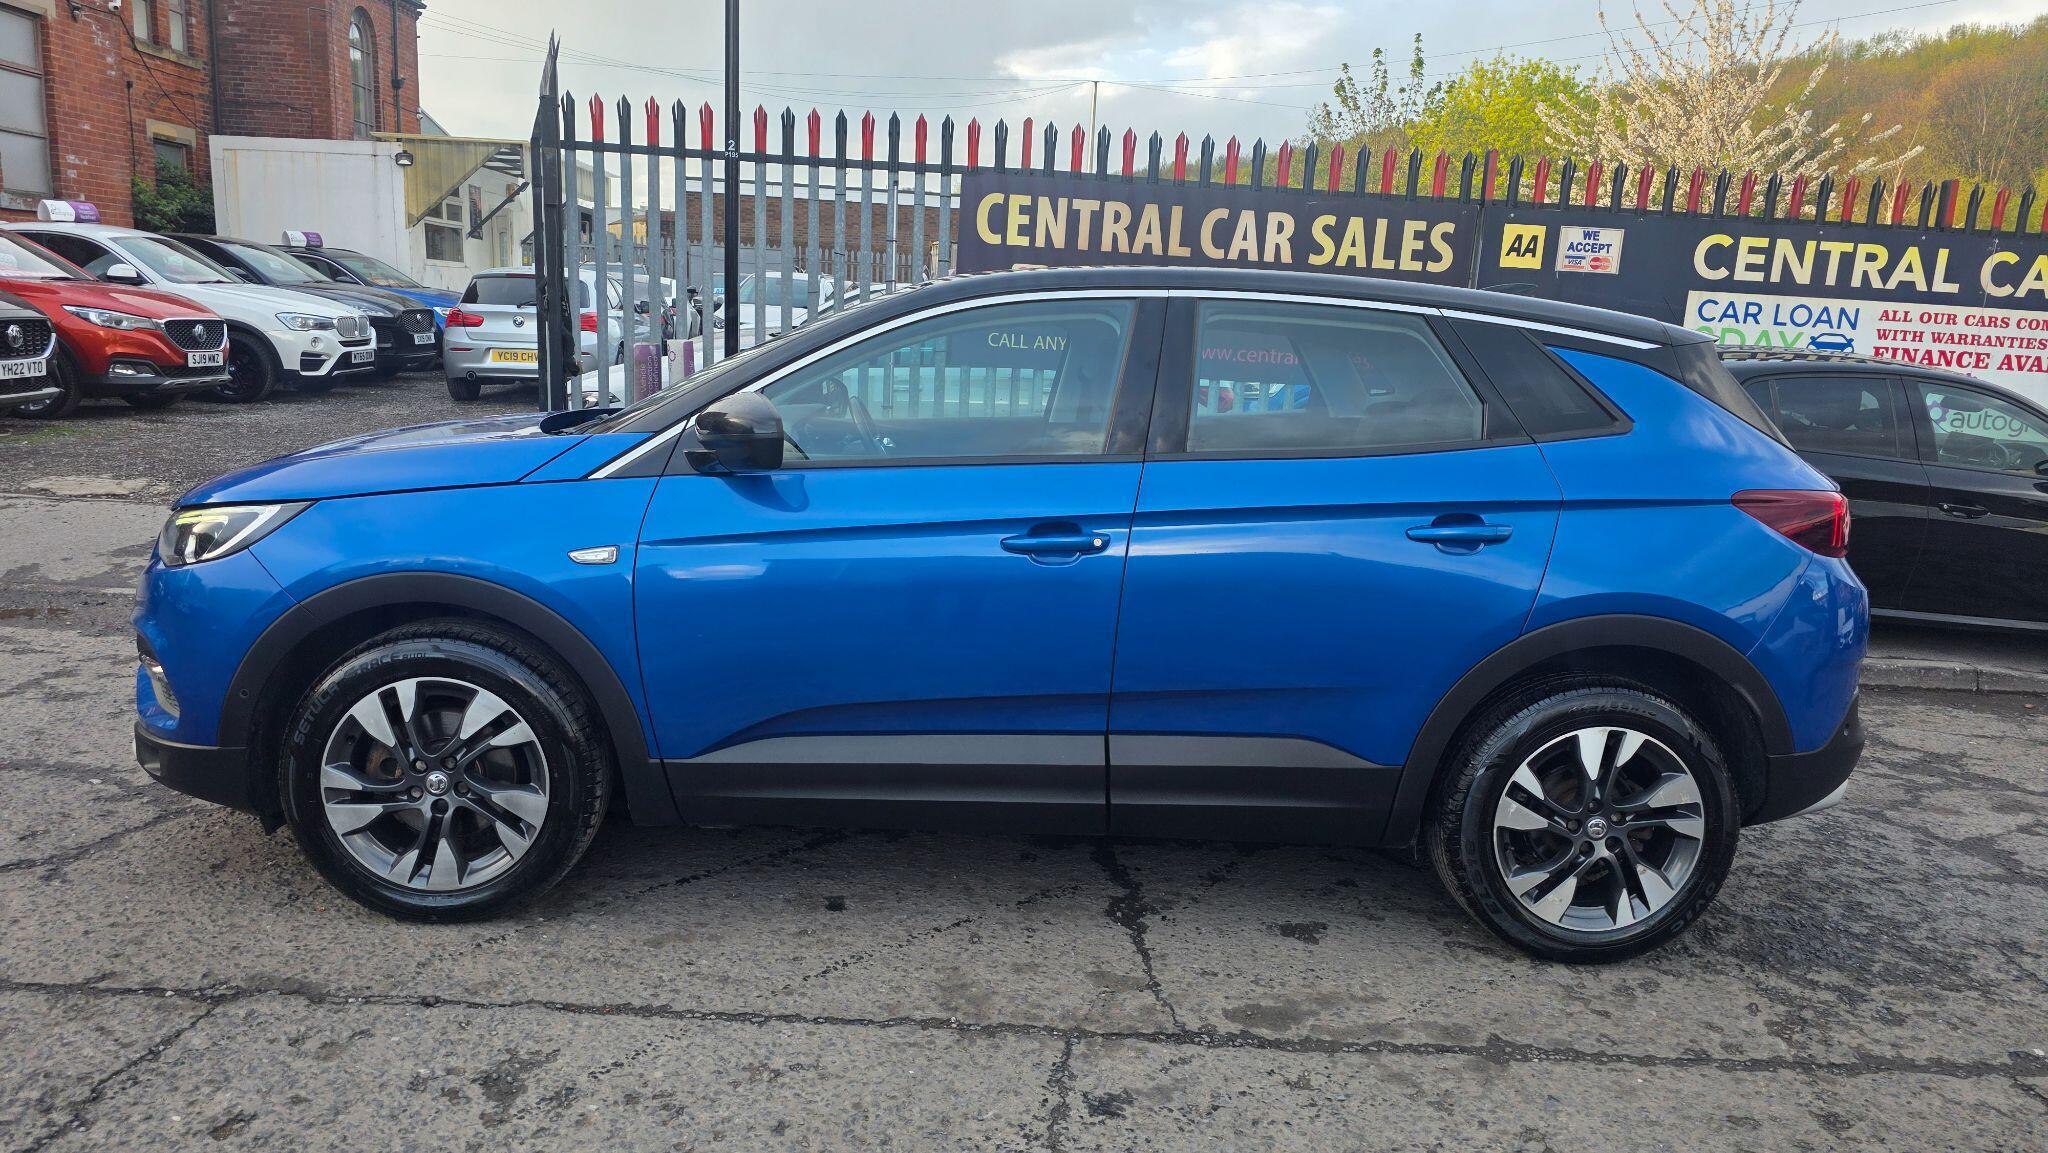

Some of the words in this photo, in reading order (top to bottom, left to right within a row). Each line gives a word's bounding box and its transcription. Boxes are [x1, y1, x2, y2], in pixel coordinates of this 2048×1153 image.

[728, 140, 735, 150] 2
[976, 192, 1192, 257] CENTRAL
[1200, 208, 1296, 263] CAR
[1308, 214, 1456, 273] SALES
[1582, 230, 1601, 241] WE
[1504, 233, 1539, 258] AA
[1566, 241, 1613, 254] ACCEPT
[1693, 234, 1960, 294] CENTRAL
[1697, 298, 1763, 325] CAR
[1772, 303, 1860, 331] LOAN
[1878, 309, 1913, 323] ALL
[1919, 311, 1958, 326] OUR
[1964, 314, 2011, 329] CARS
[987, 332, 1029, 349] CALL
[1033, 335, 1067, 351] ANY
[1876, 328, 1925, 343] WITH
[1931, 331, 2048, 351] WARRANTIES
[192, 354, 207, 365] SJ19
[497, 351, 519, 361] YC19
[1872, 346, 1991, 370] FINANCE
[1996, 353, 2048, 373] AVA
[1, 362, 25, 377] YH22
[27, 361, 43, 374] VTO
